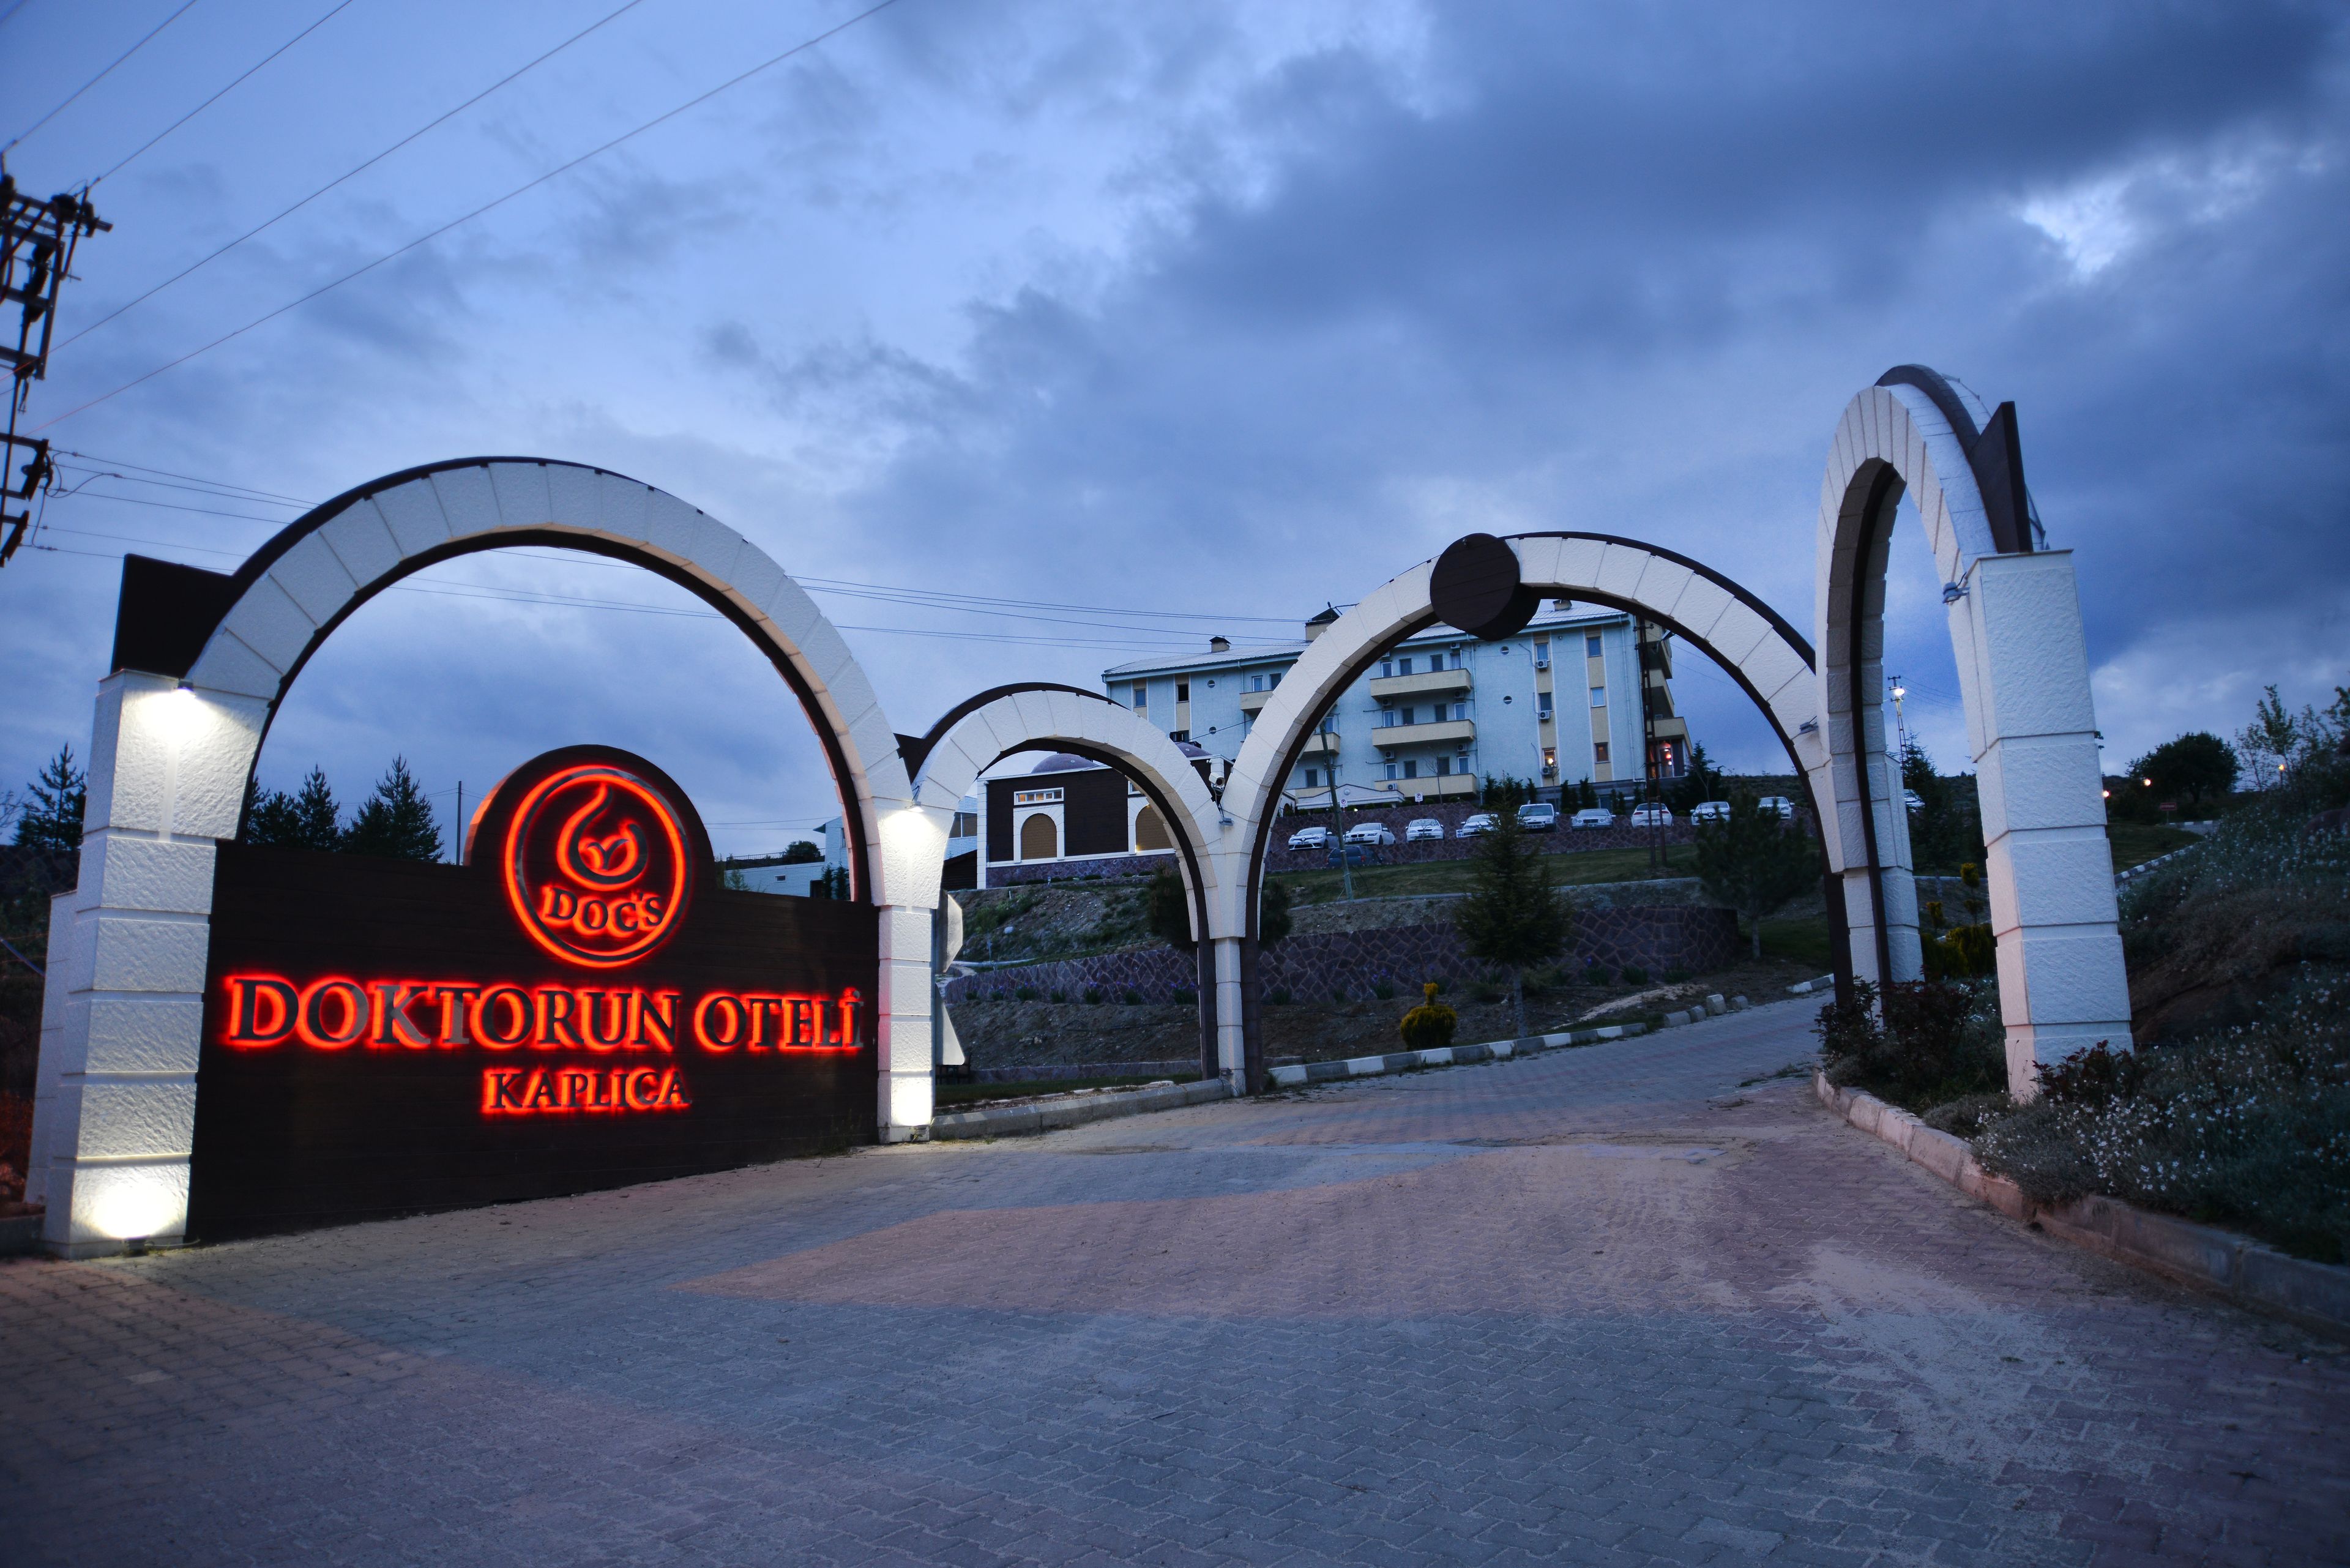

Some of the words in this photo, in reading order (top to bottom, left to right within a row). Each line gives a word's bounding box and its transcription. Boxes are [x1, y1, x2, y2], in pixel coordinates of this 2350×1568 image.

[543, 887, 665, 933] DOC'S
[226, 977, 683, 1048] DOKTORUN
[700, 989, 864, 1048] OTELİ
[487, 1070, 693, 1110] KAPLICA
